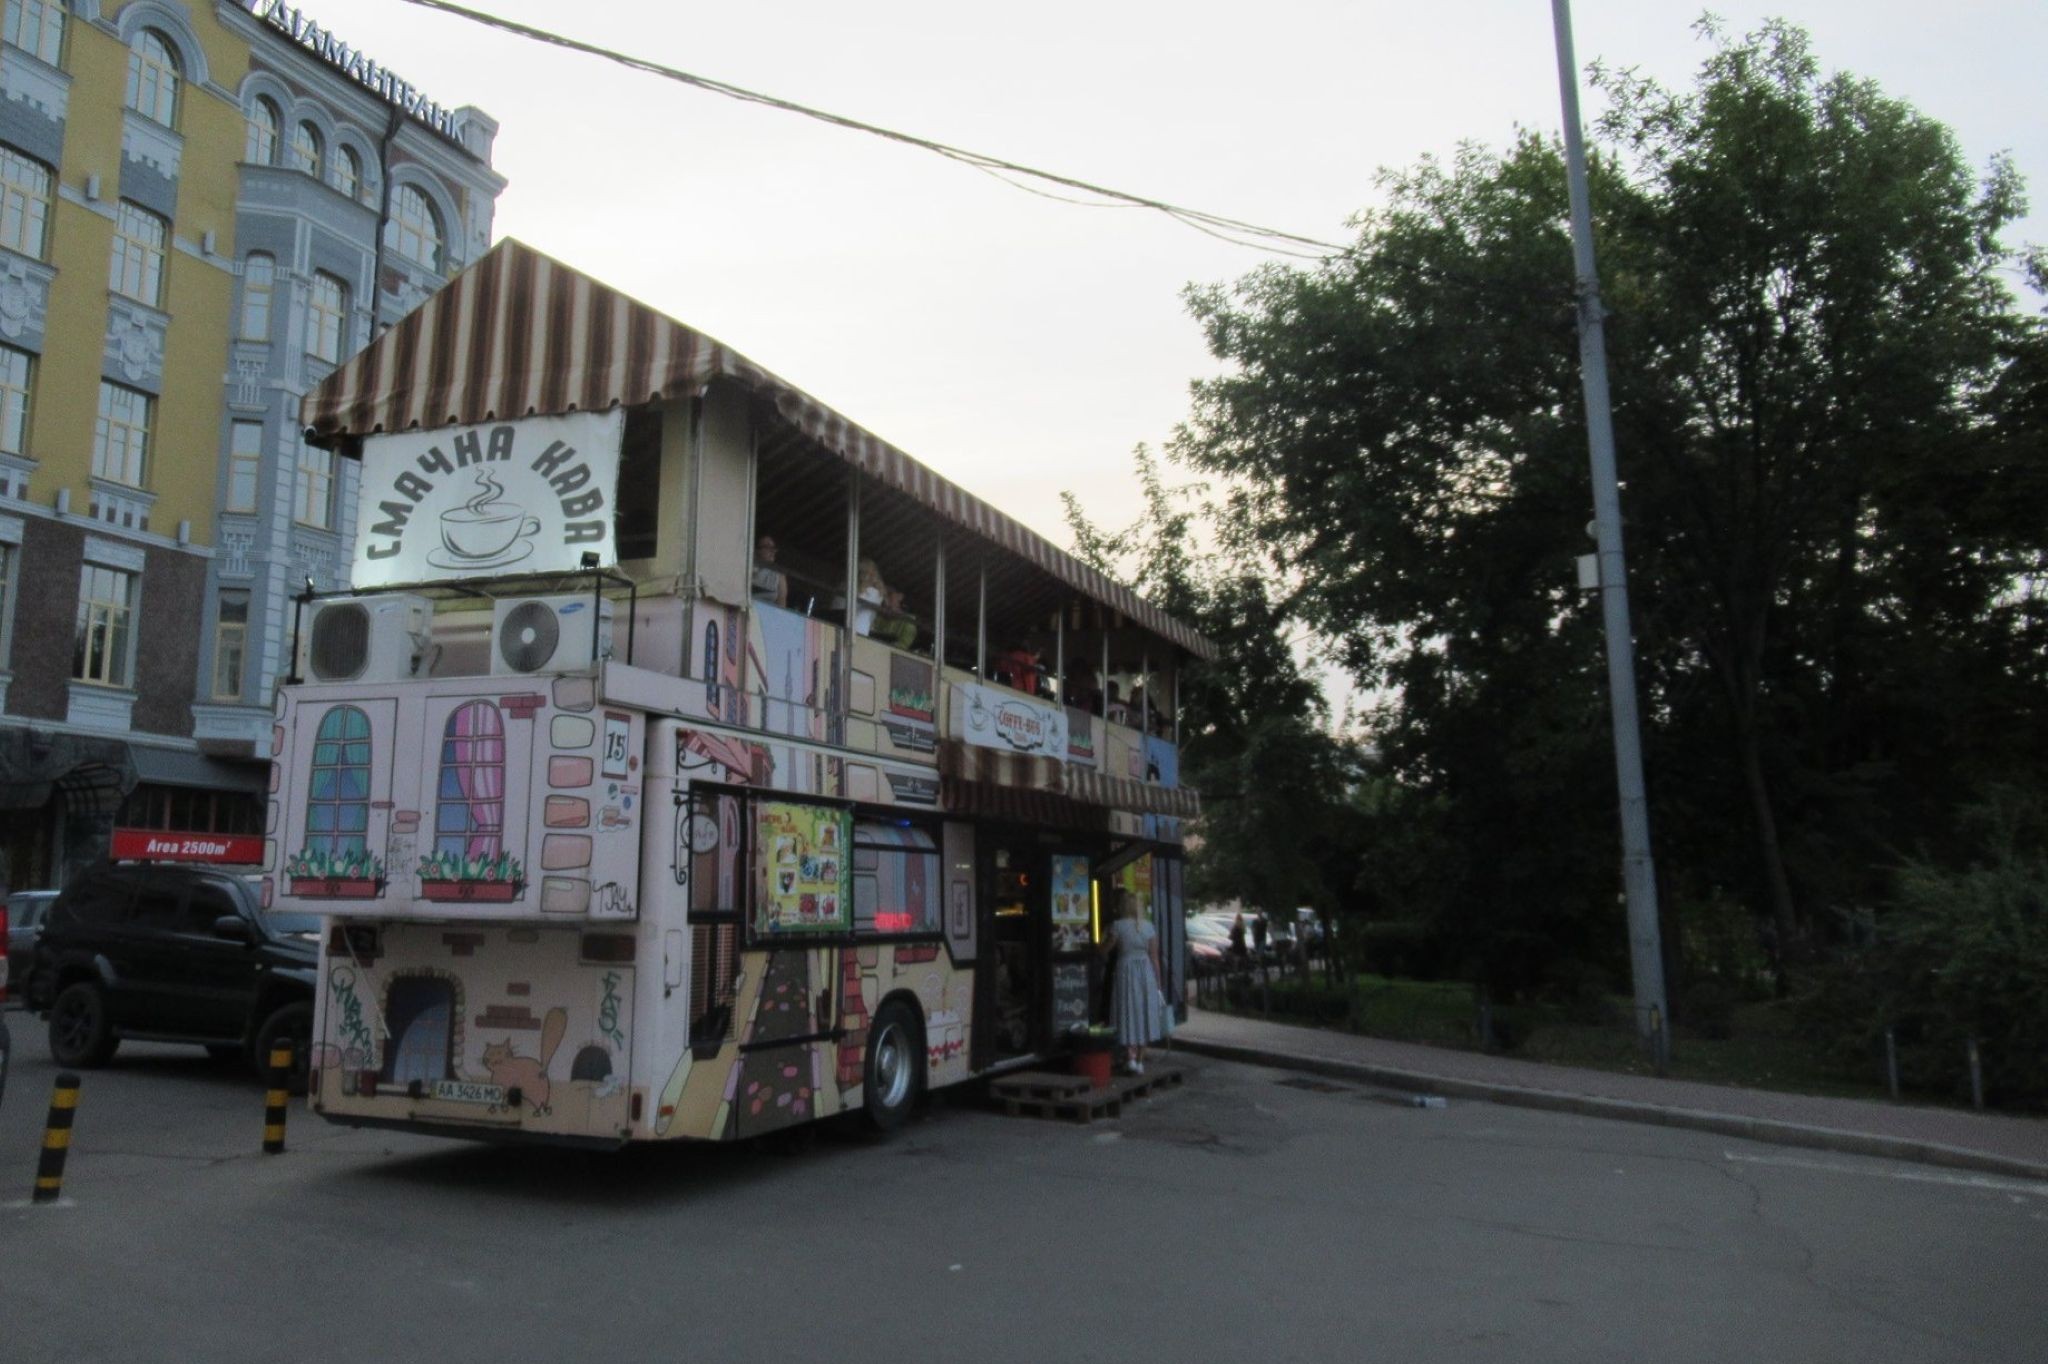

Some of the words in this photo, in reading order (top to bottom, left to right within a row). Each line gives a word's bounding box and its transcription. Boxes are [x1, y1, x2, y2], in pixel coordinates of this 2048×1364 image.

[267, 0, 465, 144] ДІАМАНТБАНК
[366, 425, 516, 561] СМАЧНА
[530, 439, 607, 545] КАВА
[606, 731, 627, 762] 15
[147, 838, 179, 854] Area
